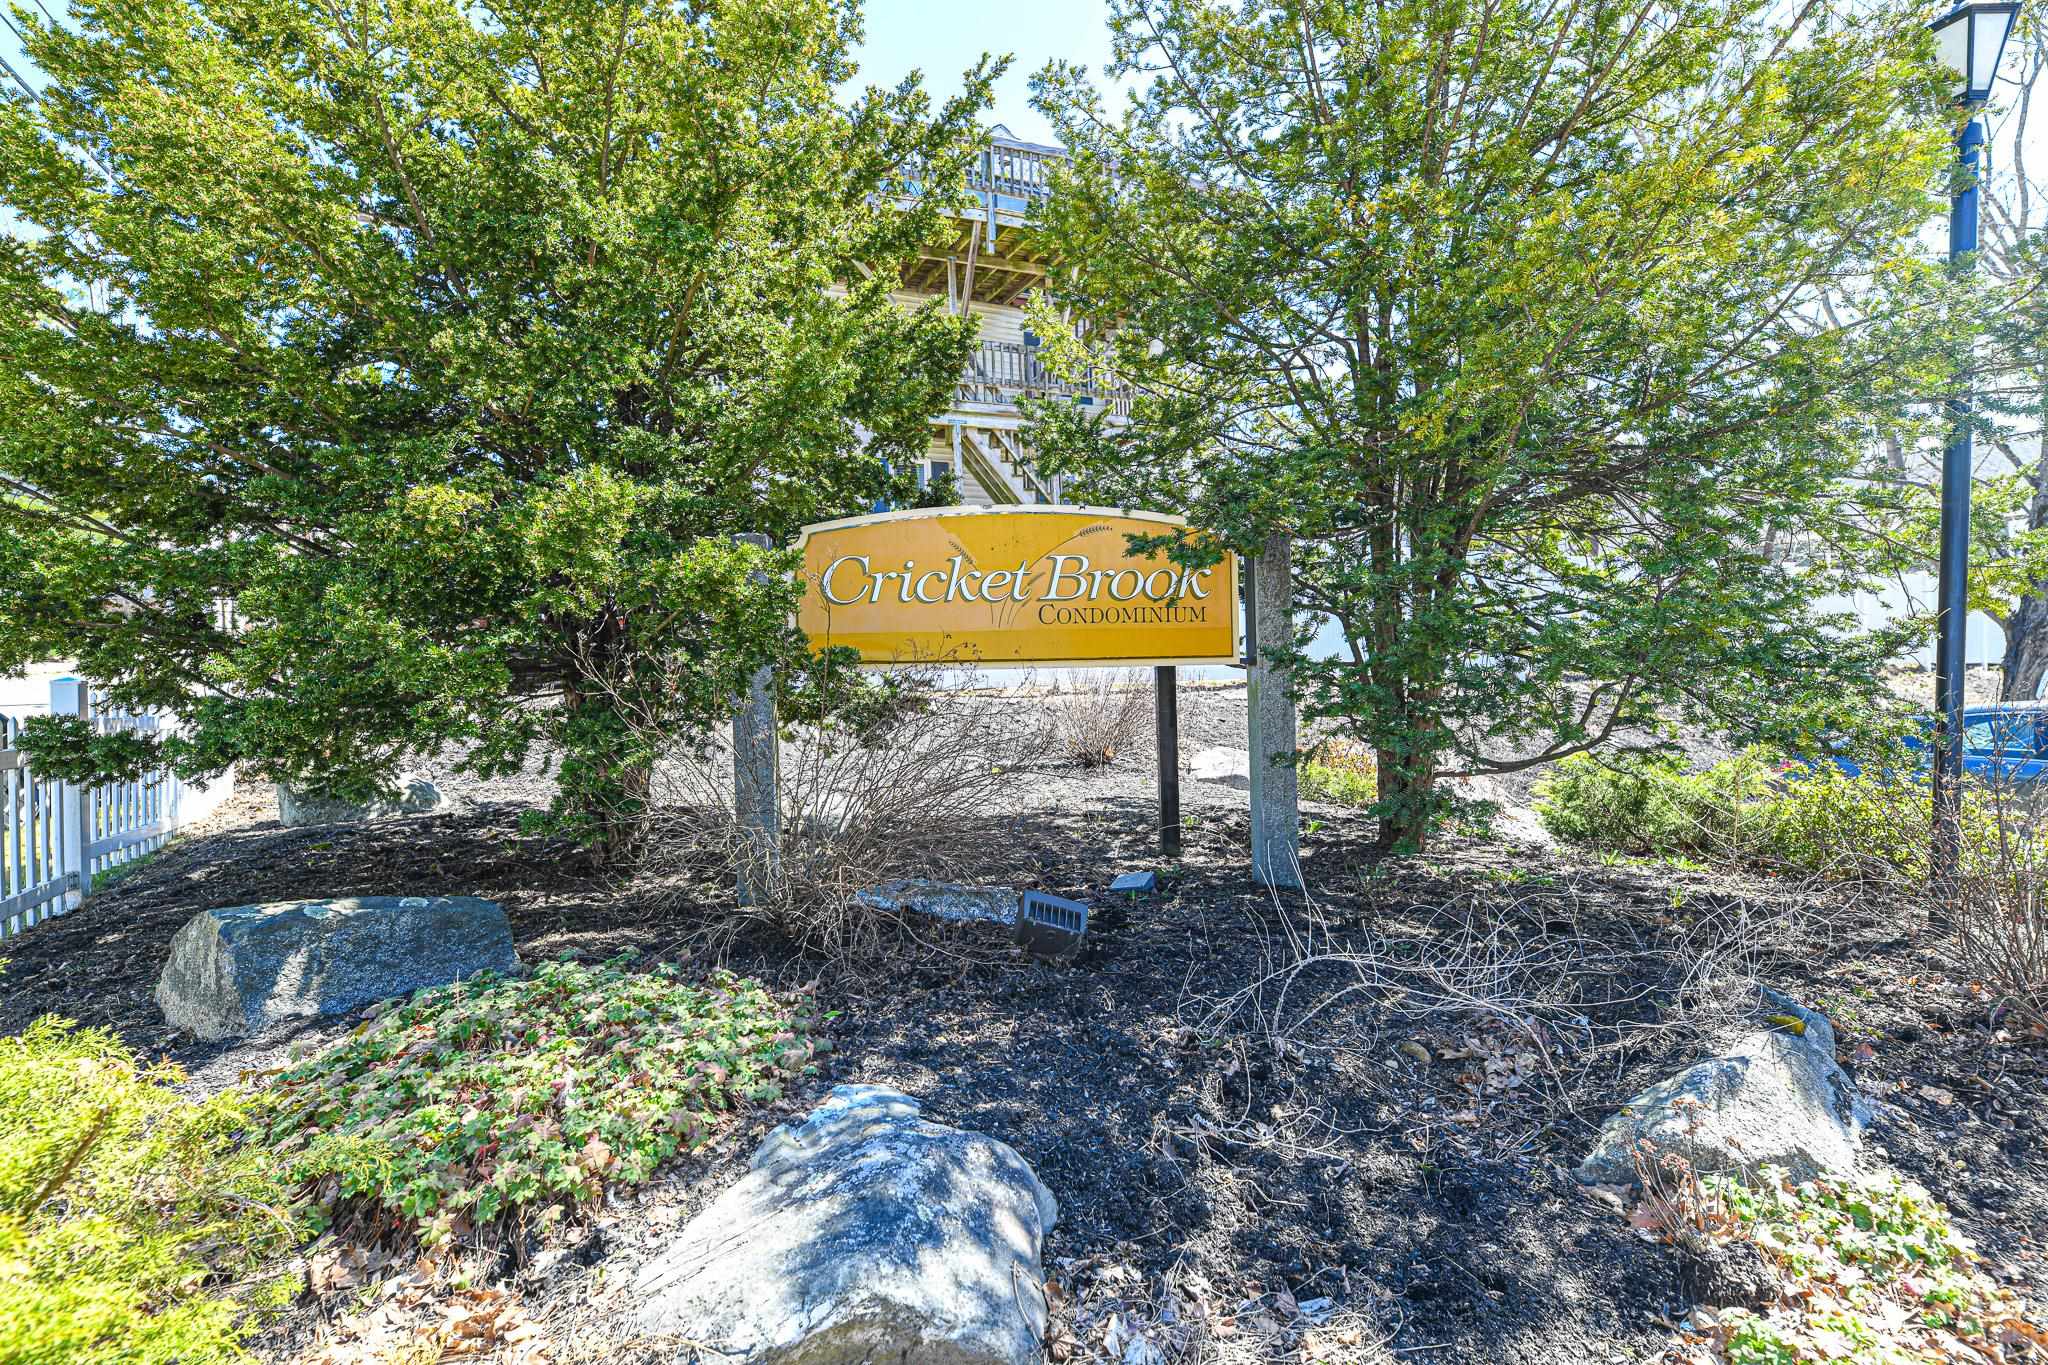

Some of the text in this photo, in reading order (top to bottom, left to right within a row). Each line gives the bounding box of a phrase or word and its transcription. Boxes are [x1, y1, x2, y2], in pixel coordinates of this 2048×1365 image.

[821, 553, 1212, 604] Cricket Brook
[1038, 604, 1207, 625] CONDOMINIUM
